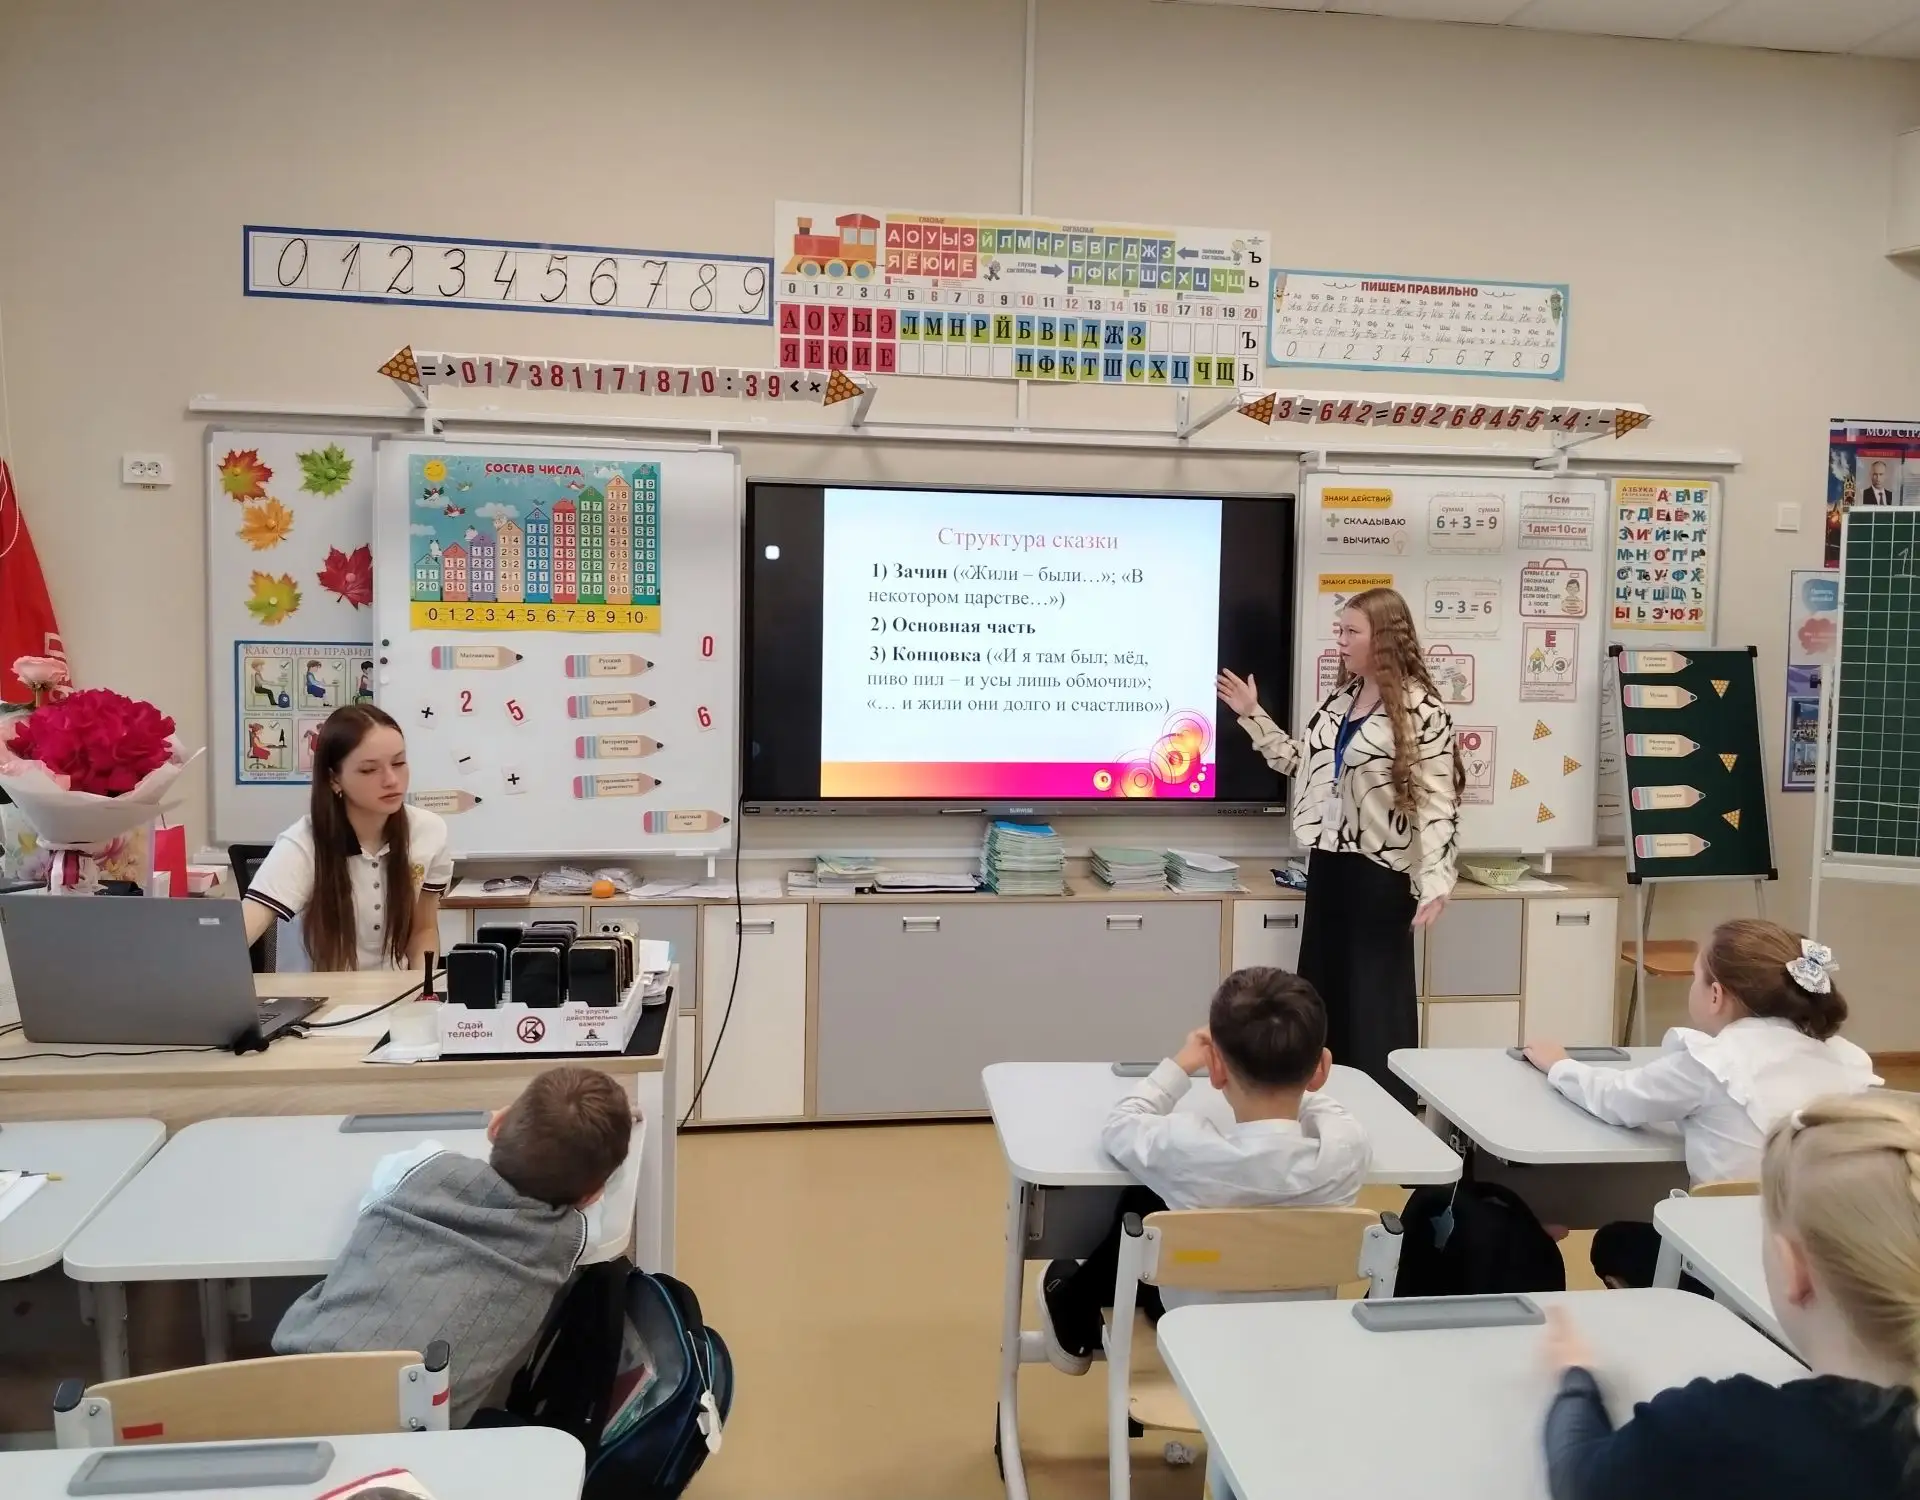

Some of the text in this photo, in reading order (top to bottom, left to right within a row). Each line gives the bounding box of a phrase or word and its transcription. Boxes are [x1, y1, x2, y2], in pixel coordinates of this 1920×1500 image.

[1361, 281, 1479, 298] ПИШЕМ ПРАВИЛЬНО
[788, 283, 1258, 320] 0 1 2 3 4 5 6 7 8 9 10 11 12 13 14 15 16 17 18 19 20
[1866, 428, 1893, 437] МОЯ
[485, 463, 582, 477] СОСТАВ ЧИСЛА
[1351, 494, 1391, 503] ДЕЙСТВИЙ
[1441, 506, 1465, 514] сумма
[1344, 518, 1406, 526] СКЛАДЫВАЮ
[1436, 516, 1446, 529] 6
[1462, 516, 1472, 529] 3
[1488, 516, 1498, 530] 9
[1527, 524, 1587, 536] 1дм=10см
[938, 527, 1119, 553] Структура сказки
[1343, 536, 1390, 545] ВЫЧИТАЮ
[872, 562, 889, 582] 1)
[893, 562, 948, 580] Зачин
[953, 564, 1019, 584] («Жили
[1121, 568, 1144, 584] «В
[869, 591, 960, 608] некотором
[1434, 600, 1444, 614] 9
[1457, 600, 1466, 614] 3
[1484, 601, 1492, 614] 6
[428, 608, 645, 624] 0 1 2 3 4 5 6 7 8 9 10
[870, 616, 1037, 636] 2) Основная часть
[245, 645, 373, 657] КАК СИДЕТЬ ПРАВИЛ
[869, 645, 1149, 667] 3) Концовка («И я там был; мёд,
[867, 674, 909, 687] пиво
[913, 675, 945, 687] пил
[964, 676, 975, 687] и
[980, 676, 1013, 691] усы
[1016, 676, 1062, 688] лишь
[1066, 673, 1153, 691] обмочил»;
[461, 690, 473, 713] 2
[902, 700, 913, 711] и
[918, 700, 963, 711] жили
[968, 700, 999, 712] они
[1003, 700, 1052, 713] долго
[1056, 700, 1066, 712] и
[1071, 699, 1171, 716] счастливо»)
[506, 699, 524, 721] 5
[697, 706, 712, 727] 6
[1459, 733, 1482, 751] Ю
[457, 1021, 484, 1031] Сдай
[448, 1031, 493, 1039] телефон
